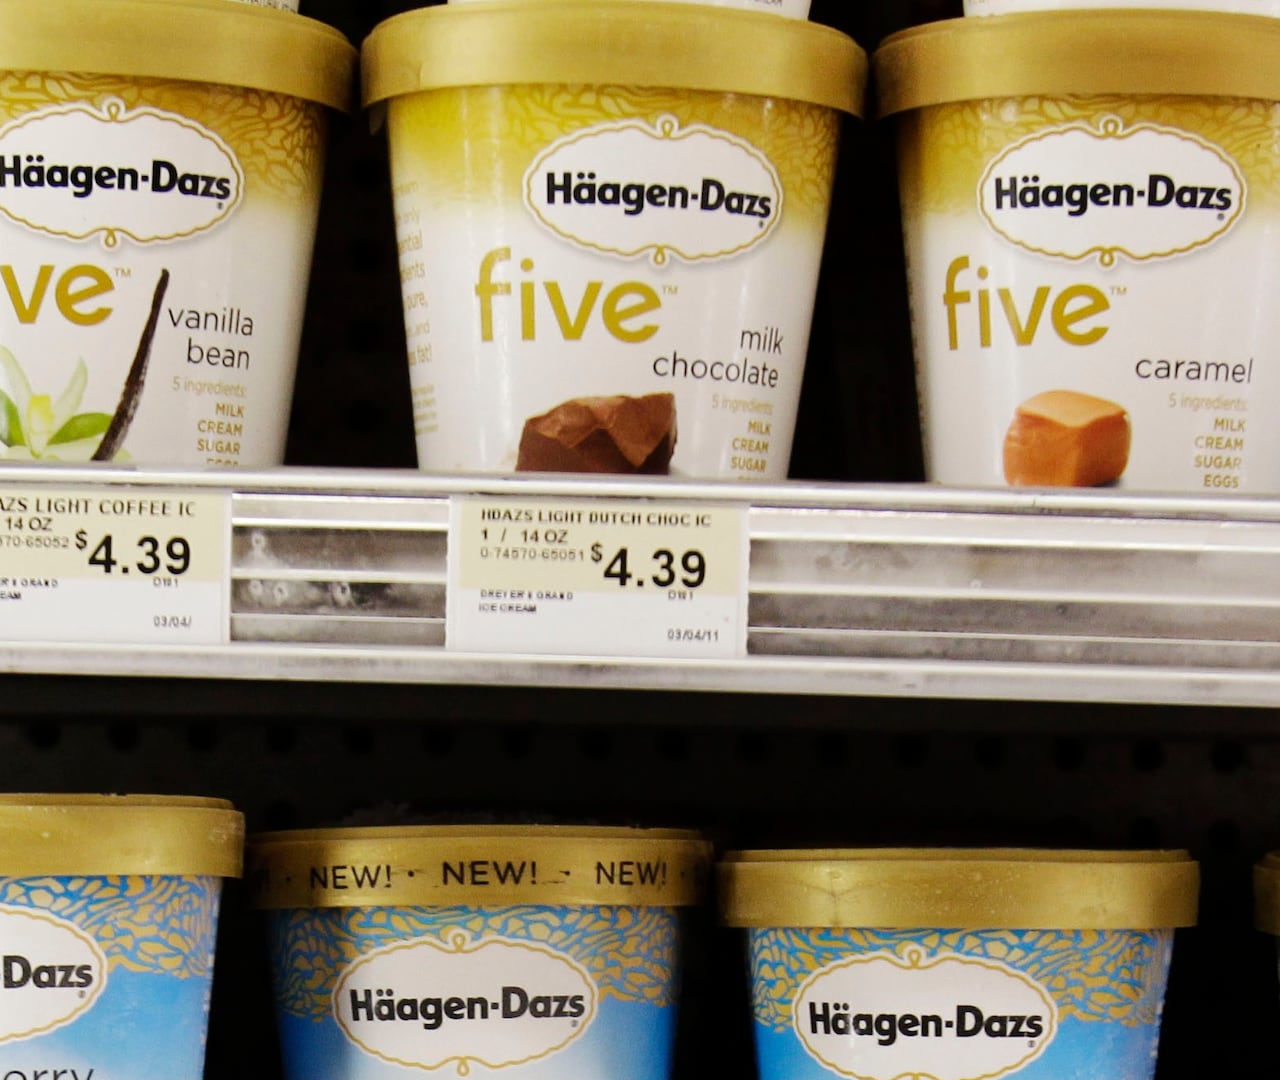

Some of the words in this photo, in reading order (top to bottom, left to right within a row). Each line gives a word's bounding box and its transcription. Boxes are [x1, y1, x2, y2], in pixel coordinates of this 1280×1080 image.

[475, 246, 662, 343] five
[943, 255, 1110, 351] five
[168, 306, 254, 337] vanilla
[187, 338, 250, 370] bean
[740, 327, 784, 354] milk
[653, 352, 779, 388] chocolate
[1135, 358, 1254, 384] caramel
[34, 498, 92, 515] LIGHT
[99, 499, 171, 516] COFFEE
[179, 501, 195, 517] IC
[481, 508, 533, 522] HDAZS
[539, 509, 584, 524] LIGHT
[589, 510, 642, 525] DUTCH
[647, 512, 690, 527] CHOC
[696, 513, 711, 527] IC
[75, 529, 191, 575] $4.39
[591, 541, 706, 588] $4.39
[309, 865, 393, 891] NEW!
[442, 860, 538, 886] NEW!
[596, 860, 668, 887] NEW!
